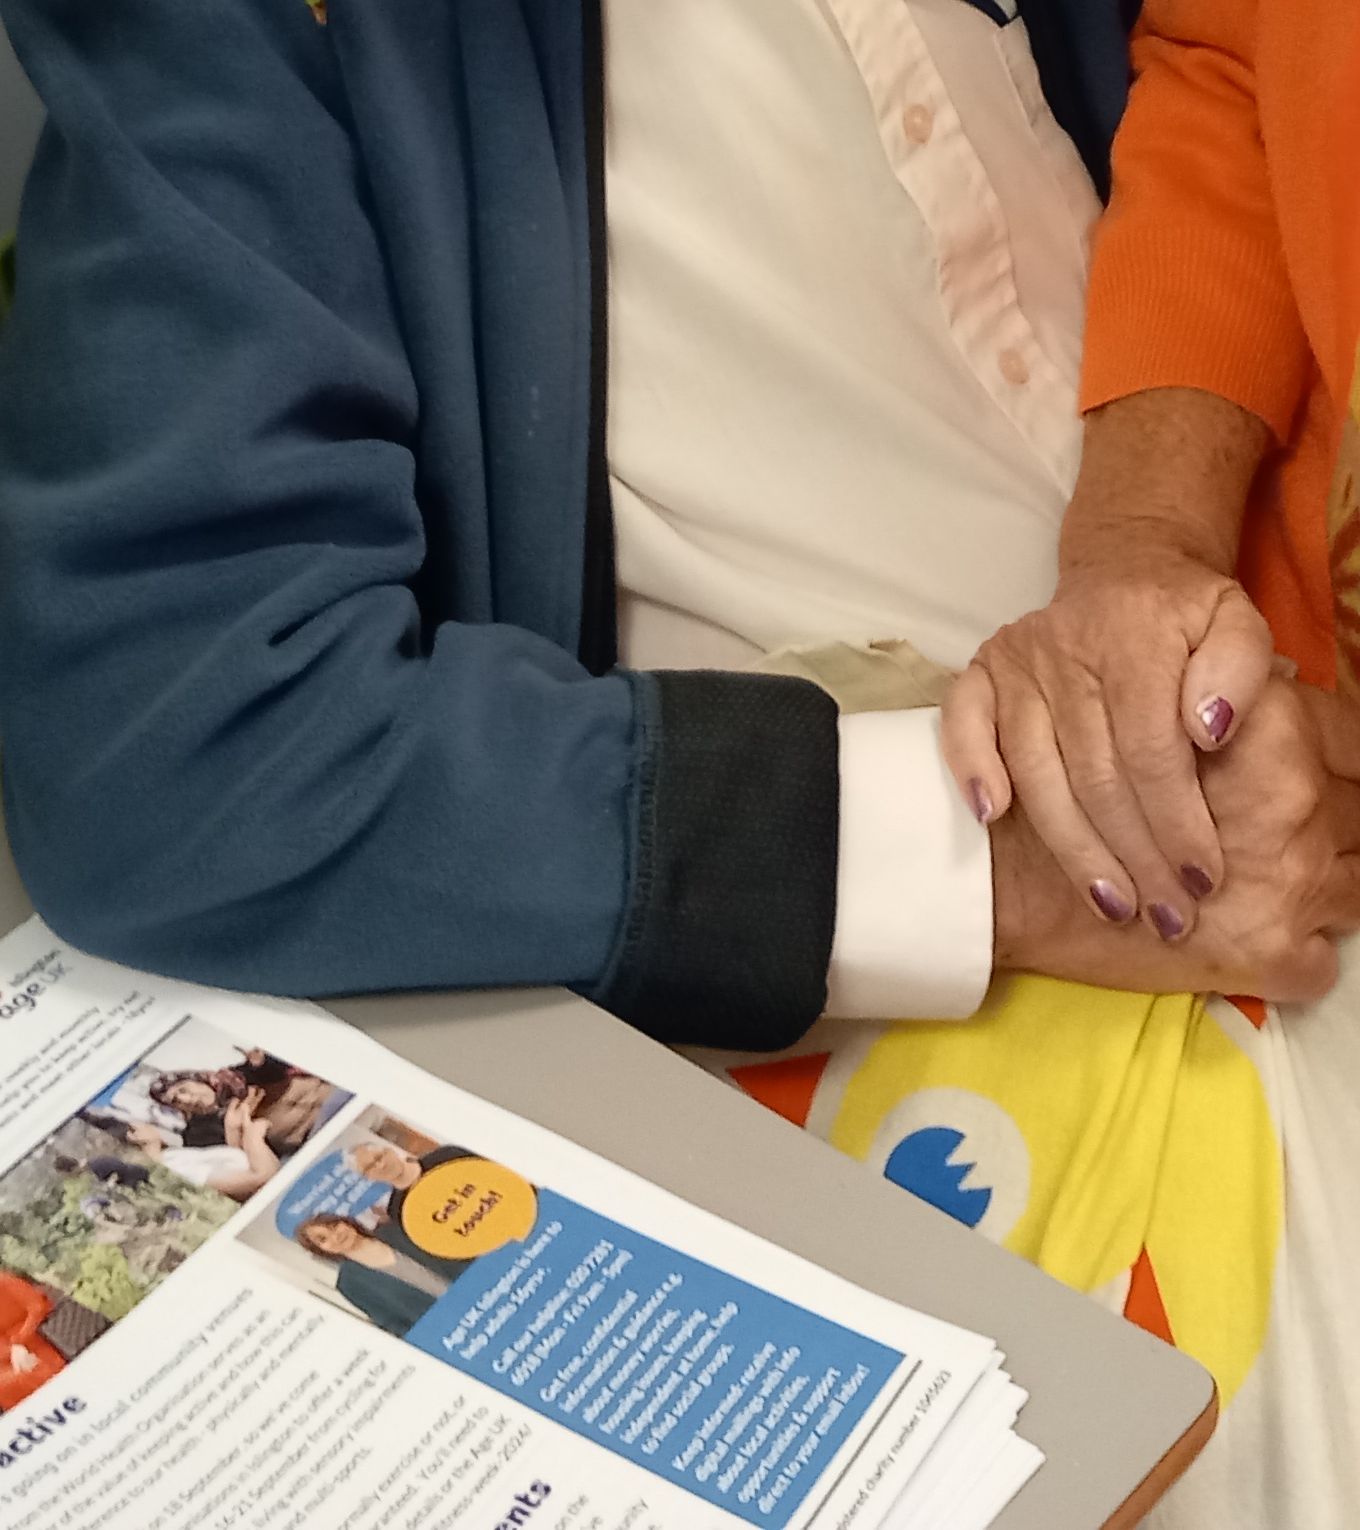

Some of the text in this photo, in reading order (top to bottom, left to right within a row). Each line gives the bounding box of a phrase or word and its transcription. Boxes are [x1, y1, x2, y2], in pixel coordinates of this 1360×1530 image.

[431, 1182, 478, 1225] Get in
[452, 1189, 504, 1238] touch!
[460, 1307, 484, 1328] UK
[130, 1333, 207, 1402] community
[492, 1347, 519, 1373] Call
[540, 1378, 565, 1402] Get
